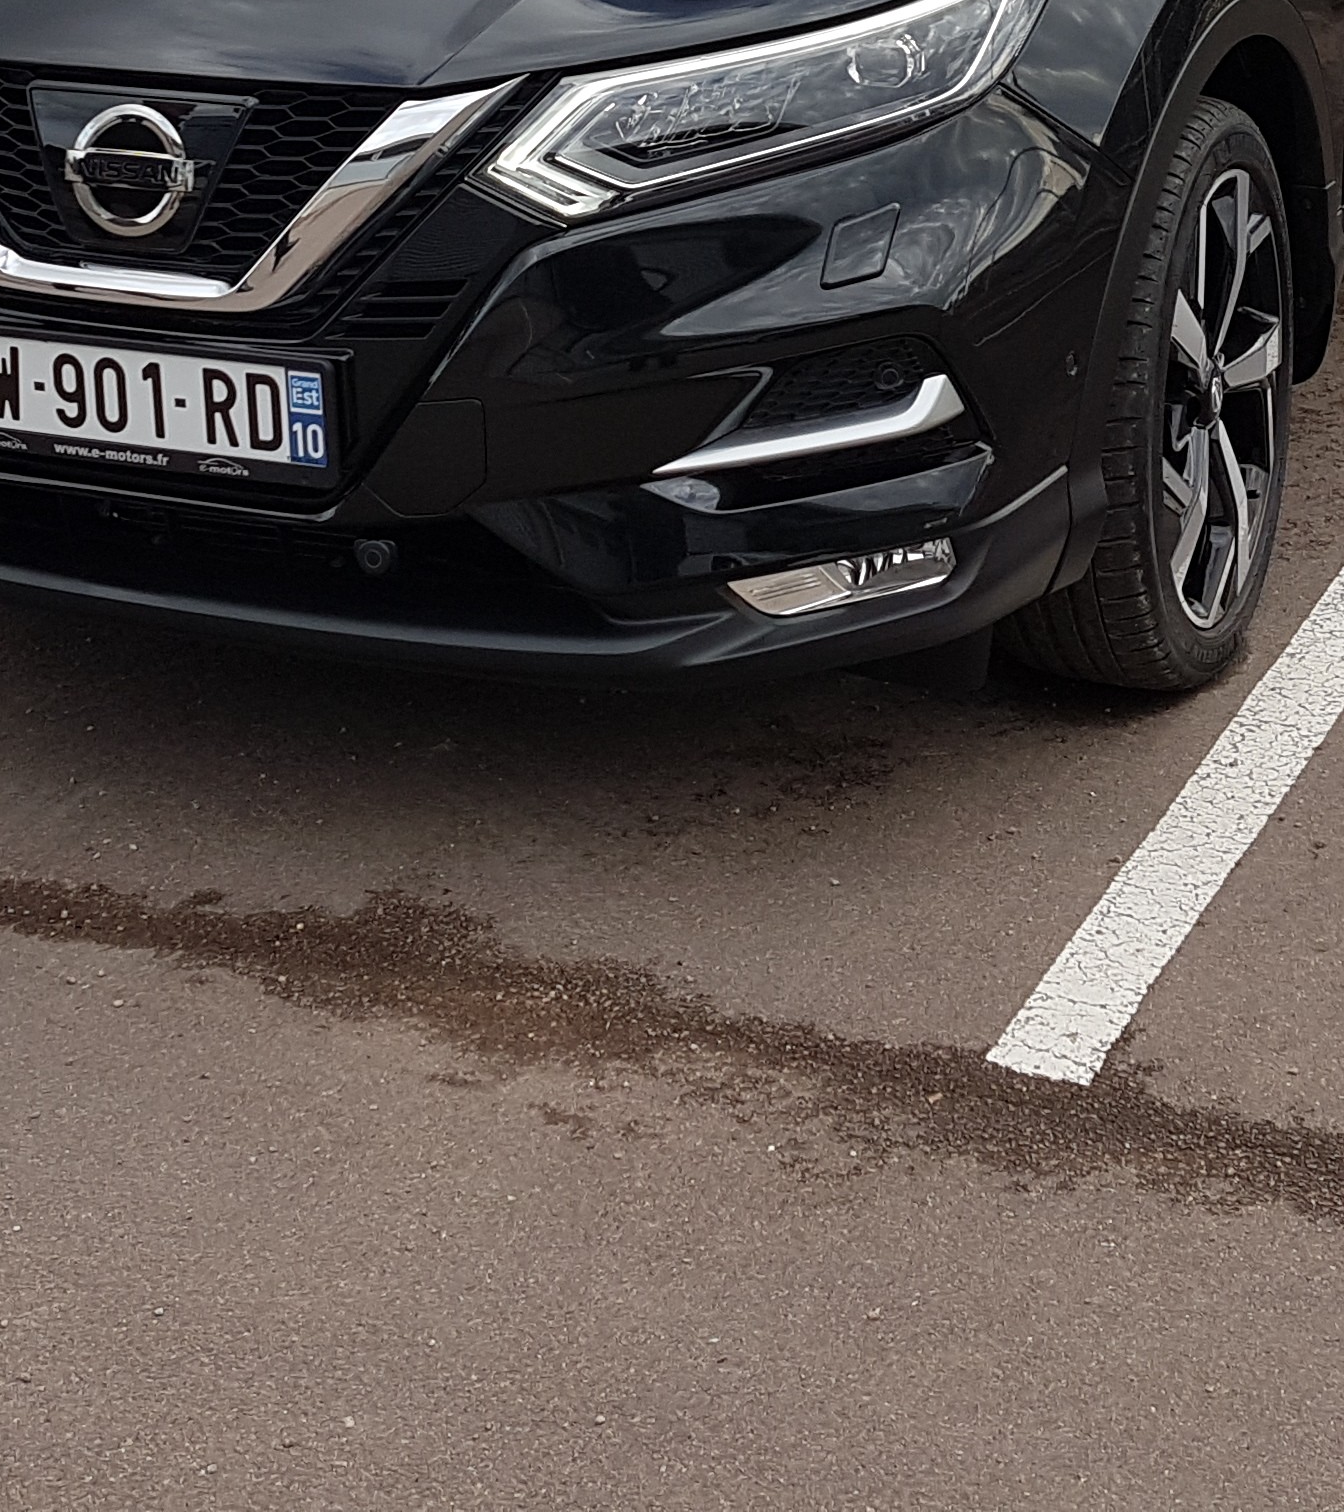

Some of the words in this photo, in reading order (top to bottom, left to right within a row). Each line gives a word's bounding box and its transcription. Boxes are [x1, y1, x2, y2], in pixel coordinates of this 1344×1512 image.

[71, 156, 182, 186] NISSAN
[291, 378, 319, 389] Grand
[292, 387, 320, 406] Est
[292, 421, 325, 459] 10
[54, 442, 169, 467] www.e-motors.fr
